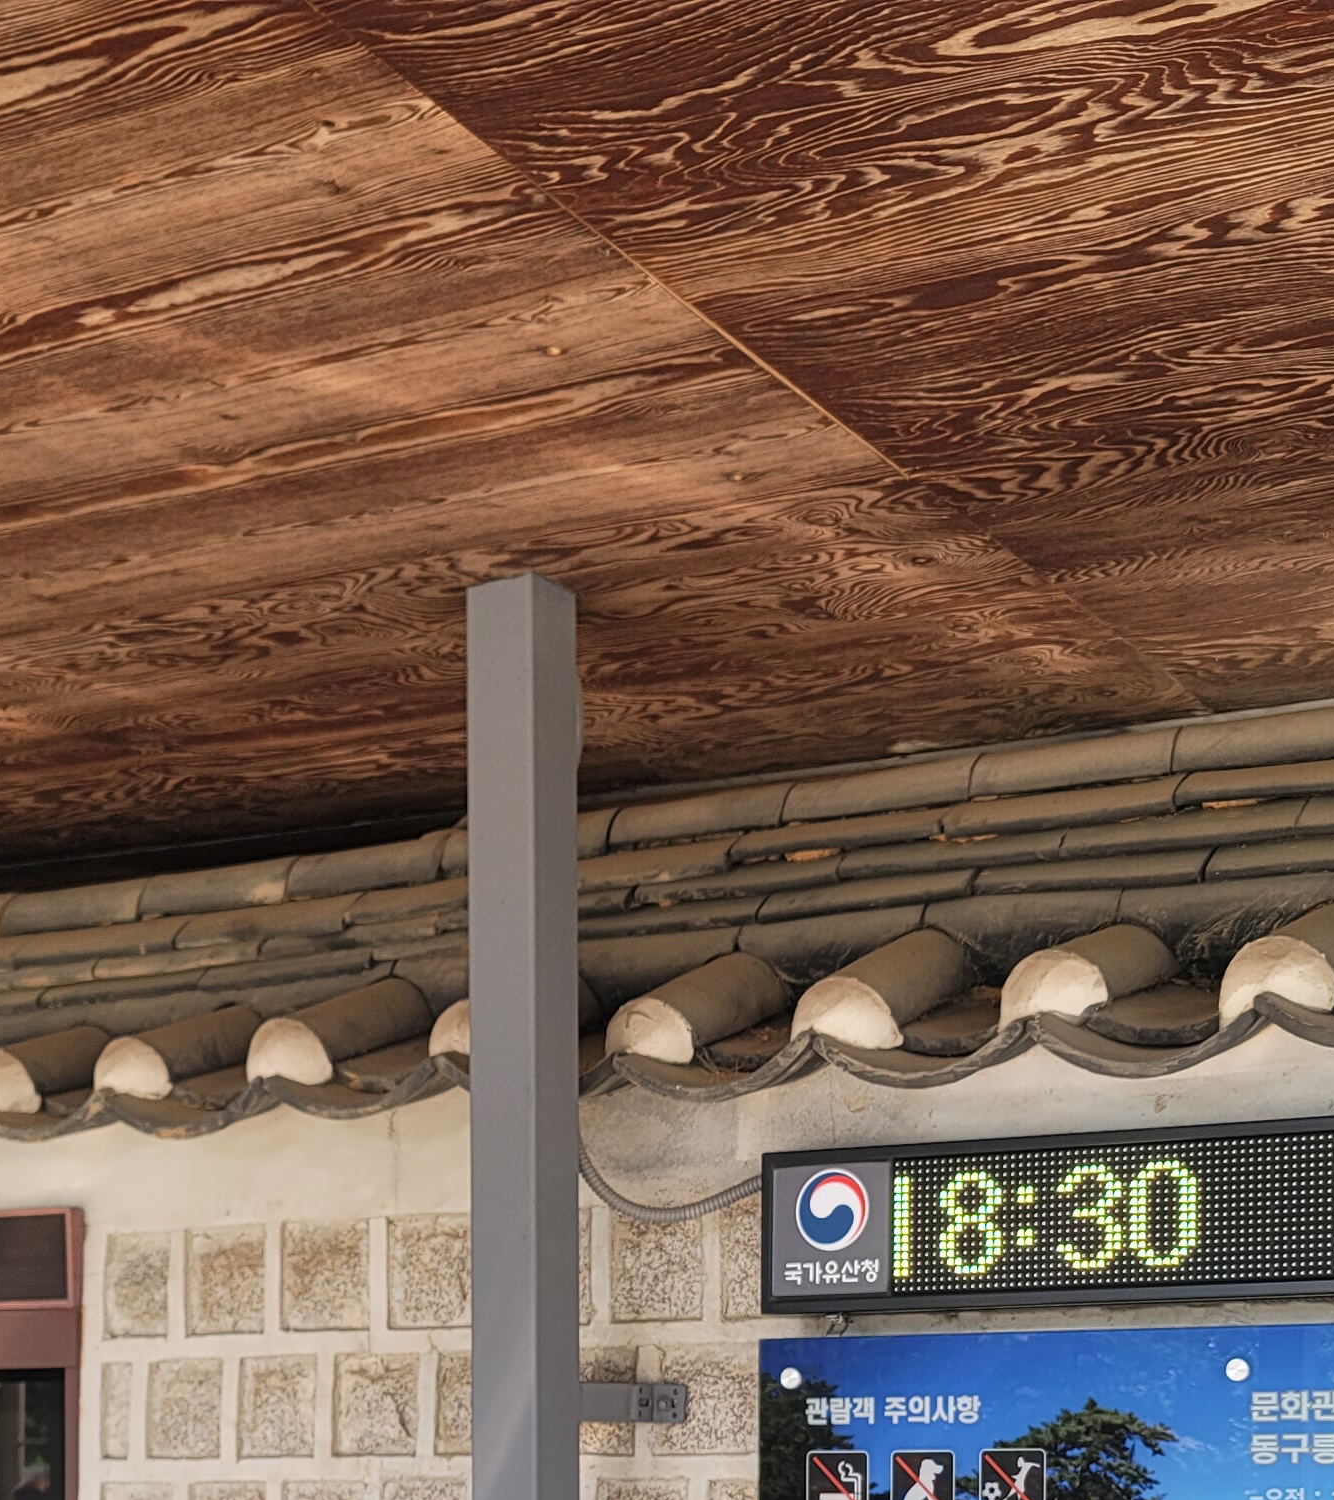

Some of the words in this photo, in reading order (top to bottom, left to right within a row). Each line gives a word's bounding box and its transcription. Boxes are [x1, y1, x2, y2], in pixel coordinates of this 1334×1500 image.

[783, 1258, 880, 1286] 국가유산청
[805, 1397, 875, 1424] 관람객
[883, 1395, 981, 1424] 주의사항
